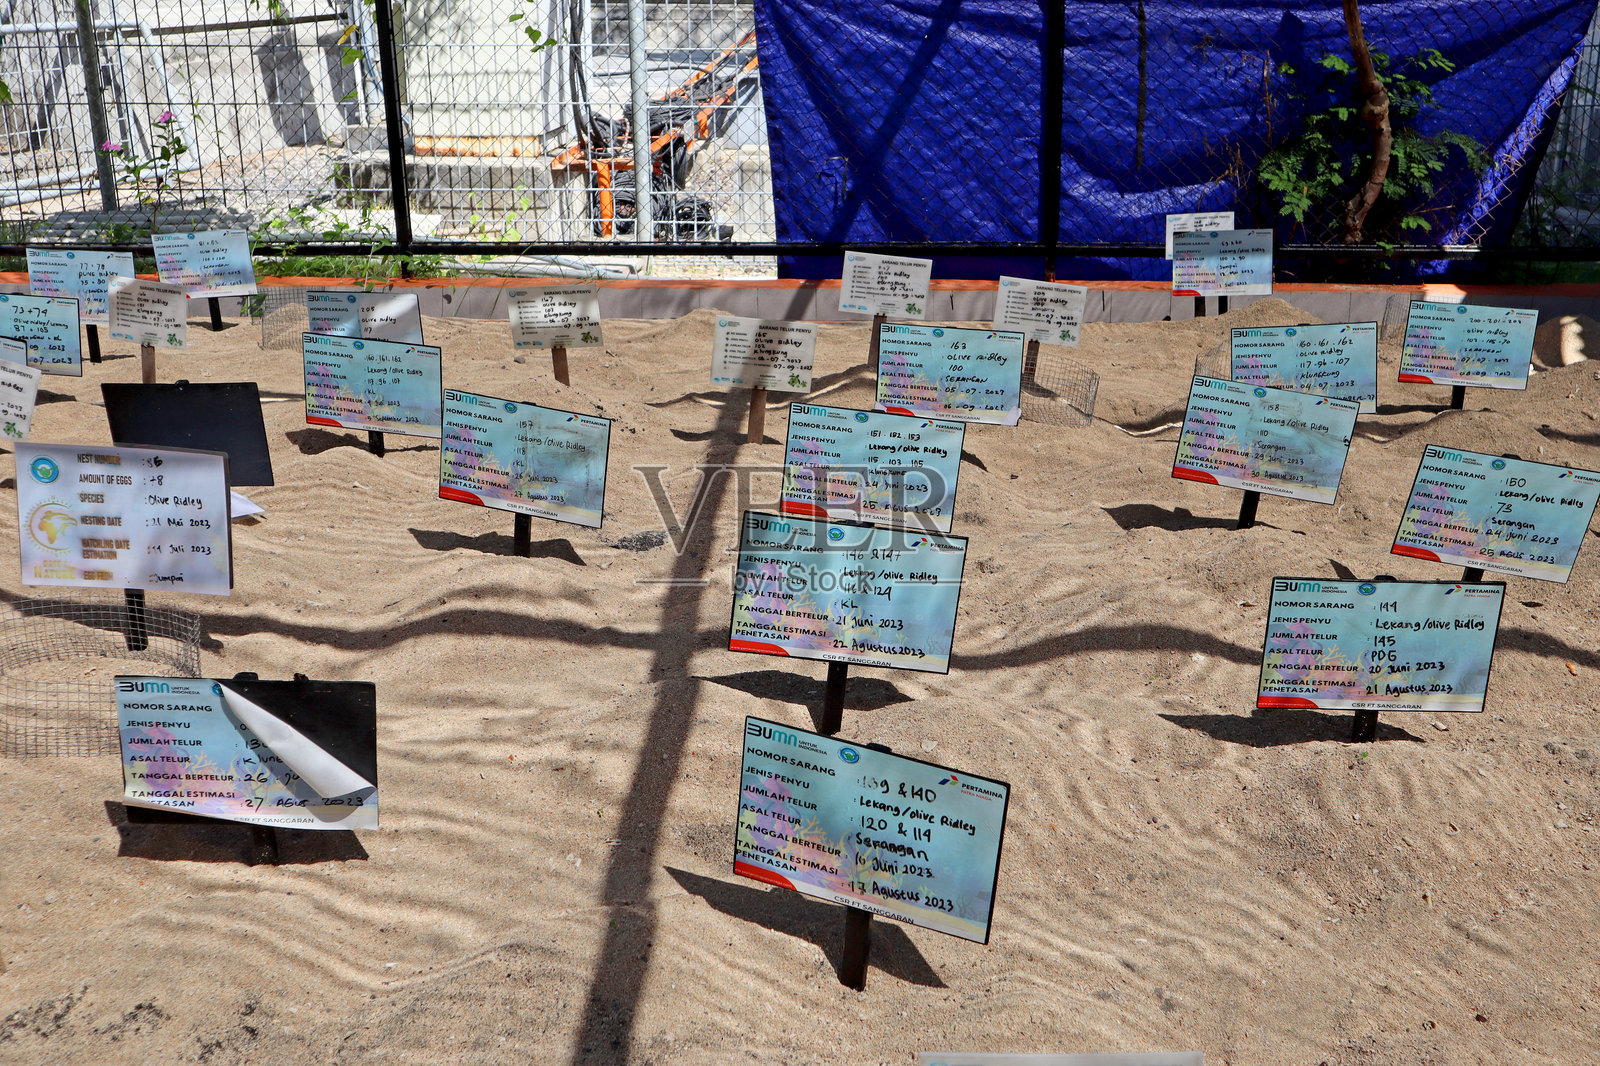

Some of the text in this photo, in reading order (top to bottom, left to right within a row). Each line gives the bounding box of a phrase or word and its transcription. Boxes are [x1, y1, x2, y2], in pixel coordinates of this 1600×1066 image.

[950, 342, 967, 350] 163
[446, 408, 503, 423] NOMOR SARANG
[519, 420, 534, 429] 157
[923, 446, 948, 458] Ridley
[77, 454, 93, 463] NEST
[1423, 465, 1486, 480] NOMOR SARANG
[79, 475, 133, 485] AMOUNT OF EGGS
[1505, 477, 1527, 488] 150
[79, 494, 105, 503] SPECIES
[174, 496, 203, 509] Ridley
[80, 516, 122, 526] NESTING DATE
[167, 518, 211, 529] Mei 2023
[115, 540, 130, 549] DATE
[191, 546, 211, 555] 2023
[746, 538, 824, 554] NOMOR SARANG
[82, 550, 117, 560] ESTIMATION
[909, 572, 938, 585] Ridley
[1274, 600, 1355, 610] NOMOR SARANG
[738, 604, 829, 622] TANGGAL BERTELUR
[736, 620, 827, 637] TANGGAL ESTIMASI
[835, 615, 904, 631] 21 Juni 2023
[1454, 619, 1485, 631] Ridley
[735, 629, 790, 641] PENETASAN
[1270, 632, 1311, 640] JUMLAH
[833, 638, 926, 658] 22 Agustus 2023
[1266, 663, 1358, 672] TANGGAL BERTELUR
[1369, 662, 1445, 674] 20 Juni 2023
[1264, 678, 1312, 687] TANGGAL
[1262, 686, 1319, 694] PENETASAN
[1366, 686, 1378, 695] 21
[1430, 684, 1453, 694] 2023
[123, 703, 213, 712] NOMOR SARANG
[155, 721, 191, 729] PENYU
[747, 747, 836, 776] NOMOR SARANG
[131, 773, 234, 782] TANGGAL BERTELUR
[243, 773, 268, 783] 26
[745, 766, 810, 789] JENIS PENYU
[961, 783, 1003, 799] PERTAMINA
[743, 784, 818, 811] JUMLAH TELUR
[244, 798, 263, 812] 27
[741, 803, 802, 825] ASAL TELUR
[861, 816, 888, 831] 120
[940, 811, 977, 836] Ridley
[739, 821, 841, 857] TANGGAL BERTELUR
[735, 850, 797, 873] PENETASAN
[737, 839, 839, 876] TANGGAL ESTIMASI
[872, 856, 899, 876] Juni
[902, 864, 935, 878] 2023
[872, 881, 920, 901] Agustus
[924, 897, 954, 912] 2023
[833, 895, 851, 906] CSR
[862, 903, 915, 925] SANGGARAN
